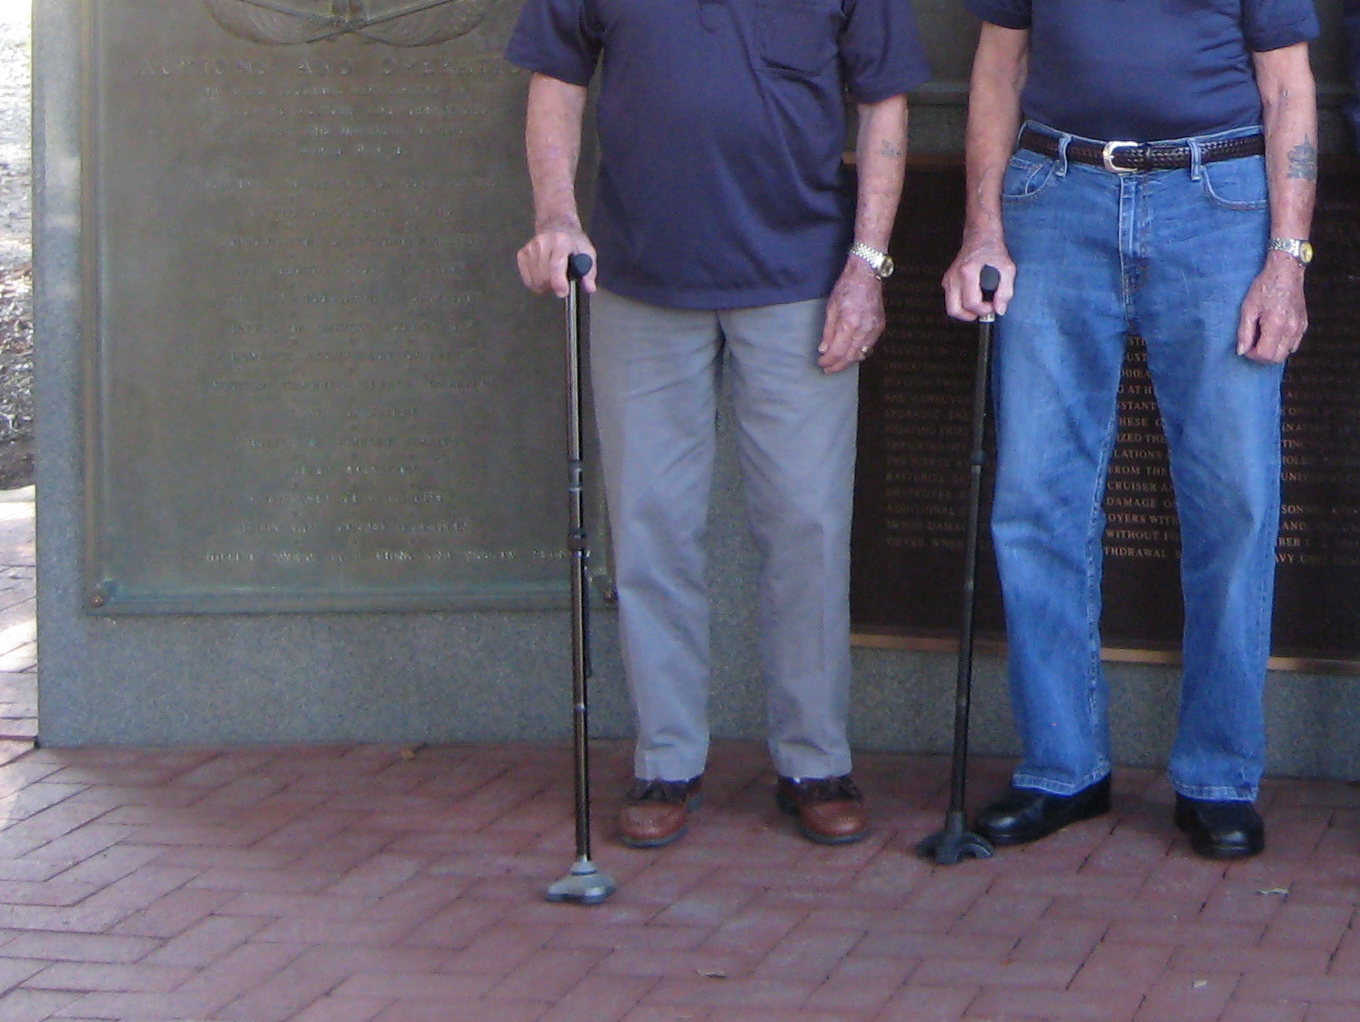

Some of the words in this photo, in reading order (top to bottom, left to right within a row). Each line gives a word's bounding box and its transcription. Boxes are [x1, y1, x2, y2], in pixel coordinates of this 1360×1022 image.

[1119, 416, 1149, 427] HESE
[1105, 514, 1147, 526] OYERS
[1104, 548, 1166, 559] THDRAWAL
